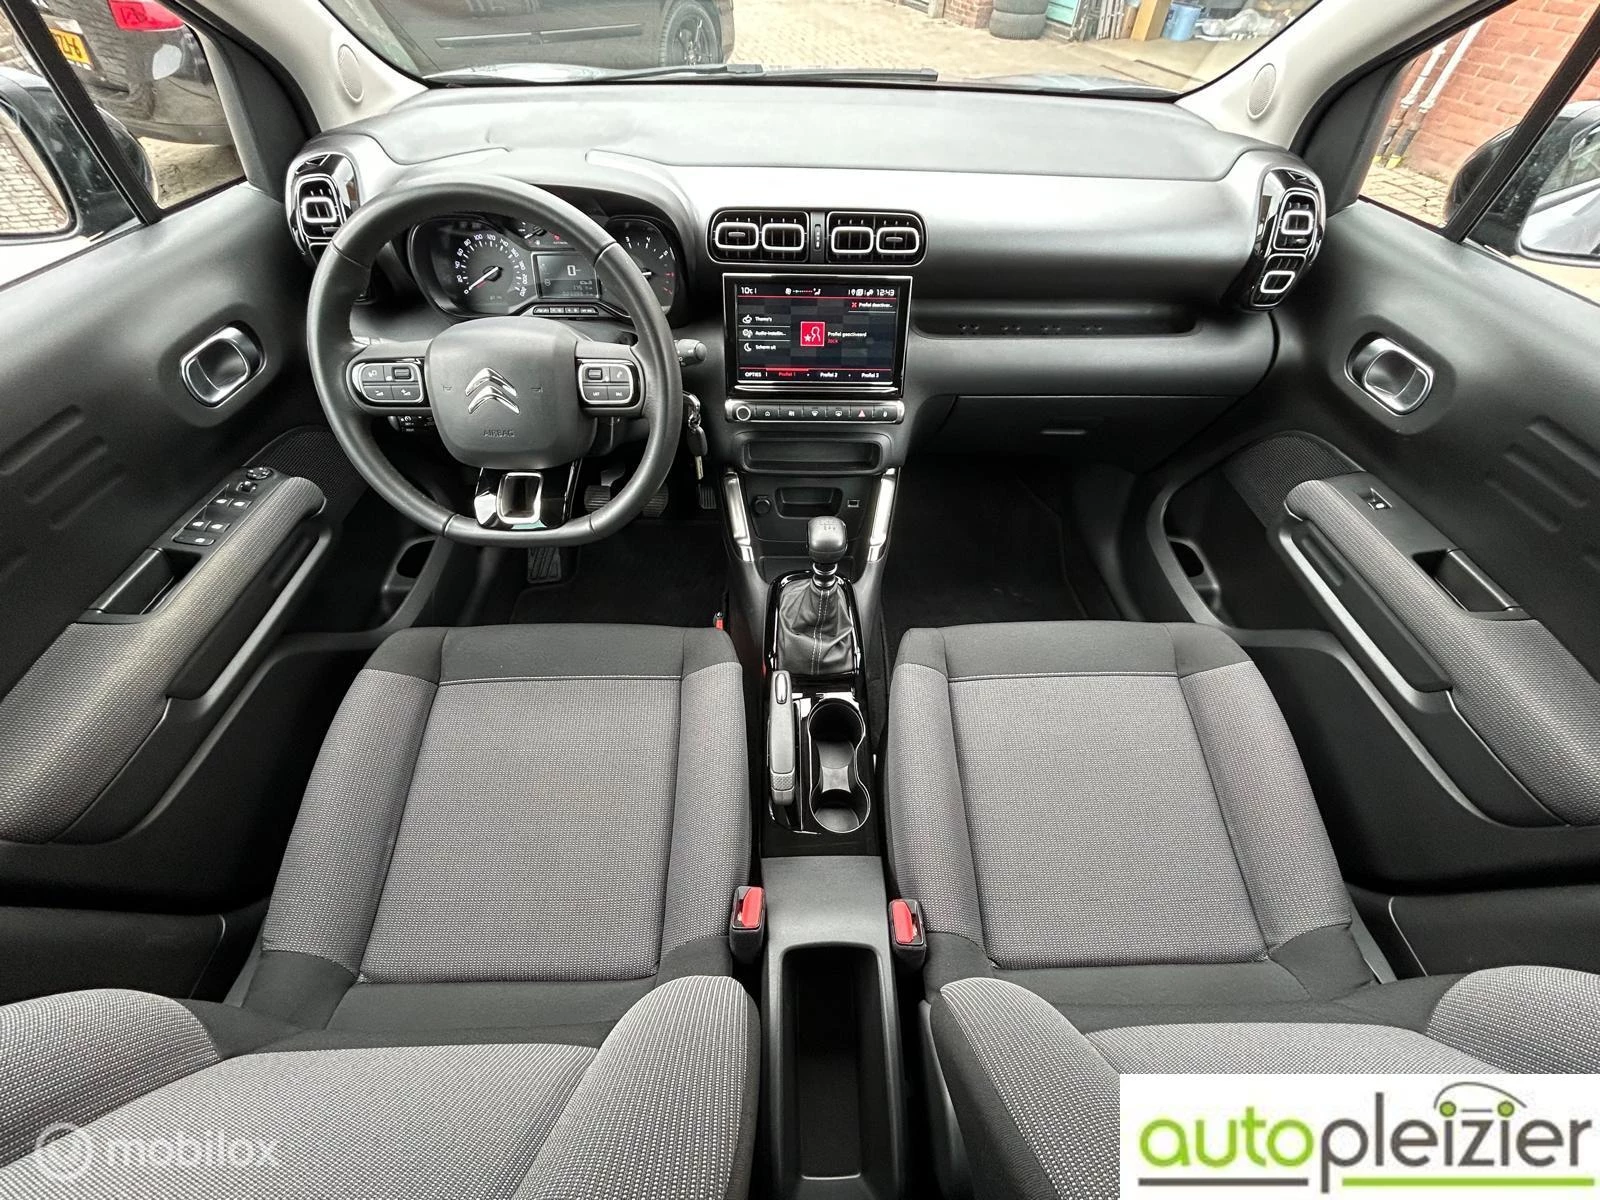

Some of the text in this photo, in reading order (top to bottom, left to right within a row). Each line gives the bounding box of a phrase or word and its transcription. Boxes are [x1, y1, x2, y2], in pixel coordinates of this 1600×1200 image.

[463, 238, 472, 247] 80
[500, 238, 508, 247] 140
[456, 247, 464, 257] 60
[510, 248, 519, 258] 160
[454, 260, 460, 269] 40
[518, 260, 526, 271] 180
[567, 265, 577, 276] 0
[456, 274, 463, 283] 20
